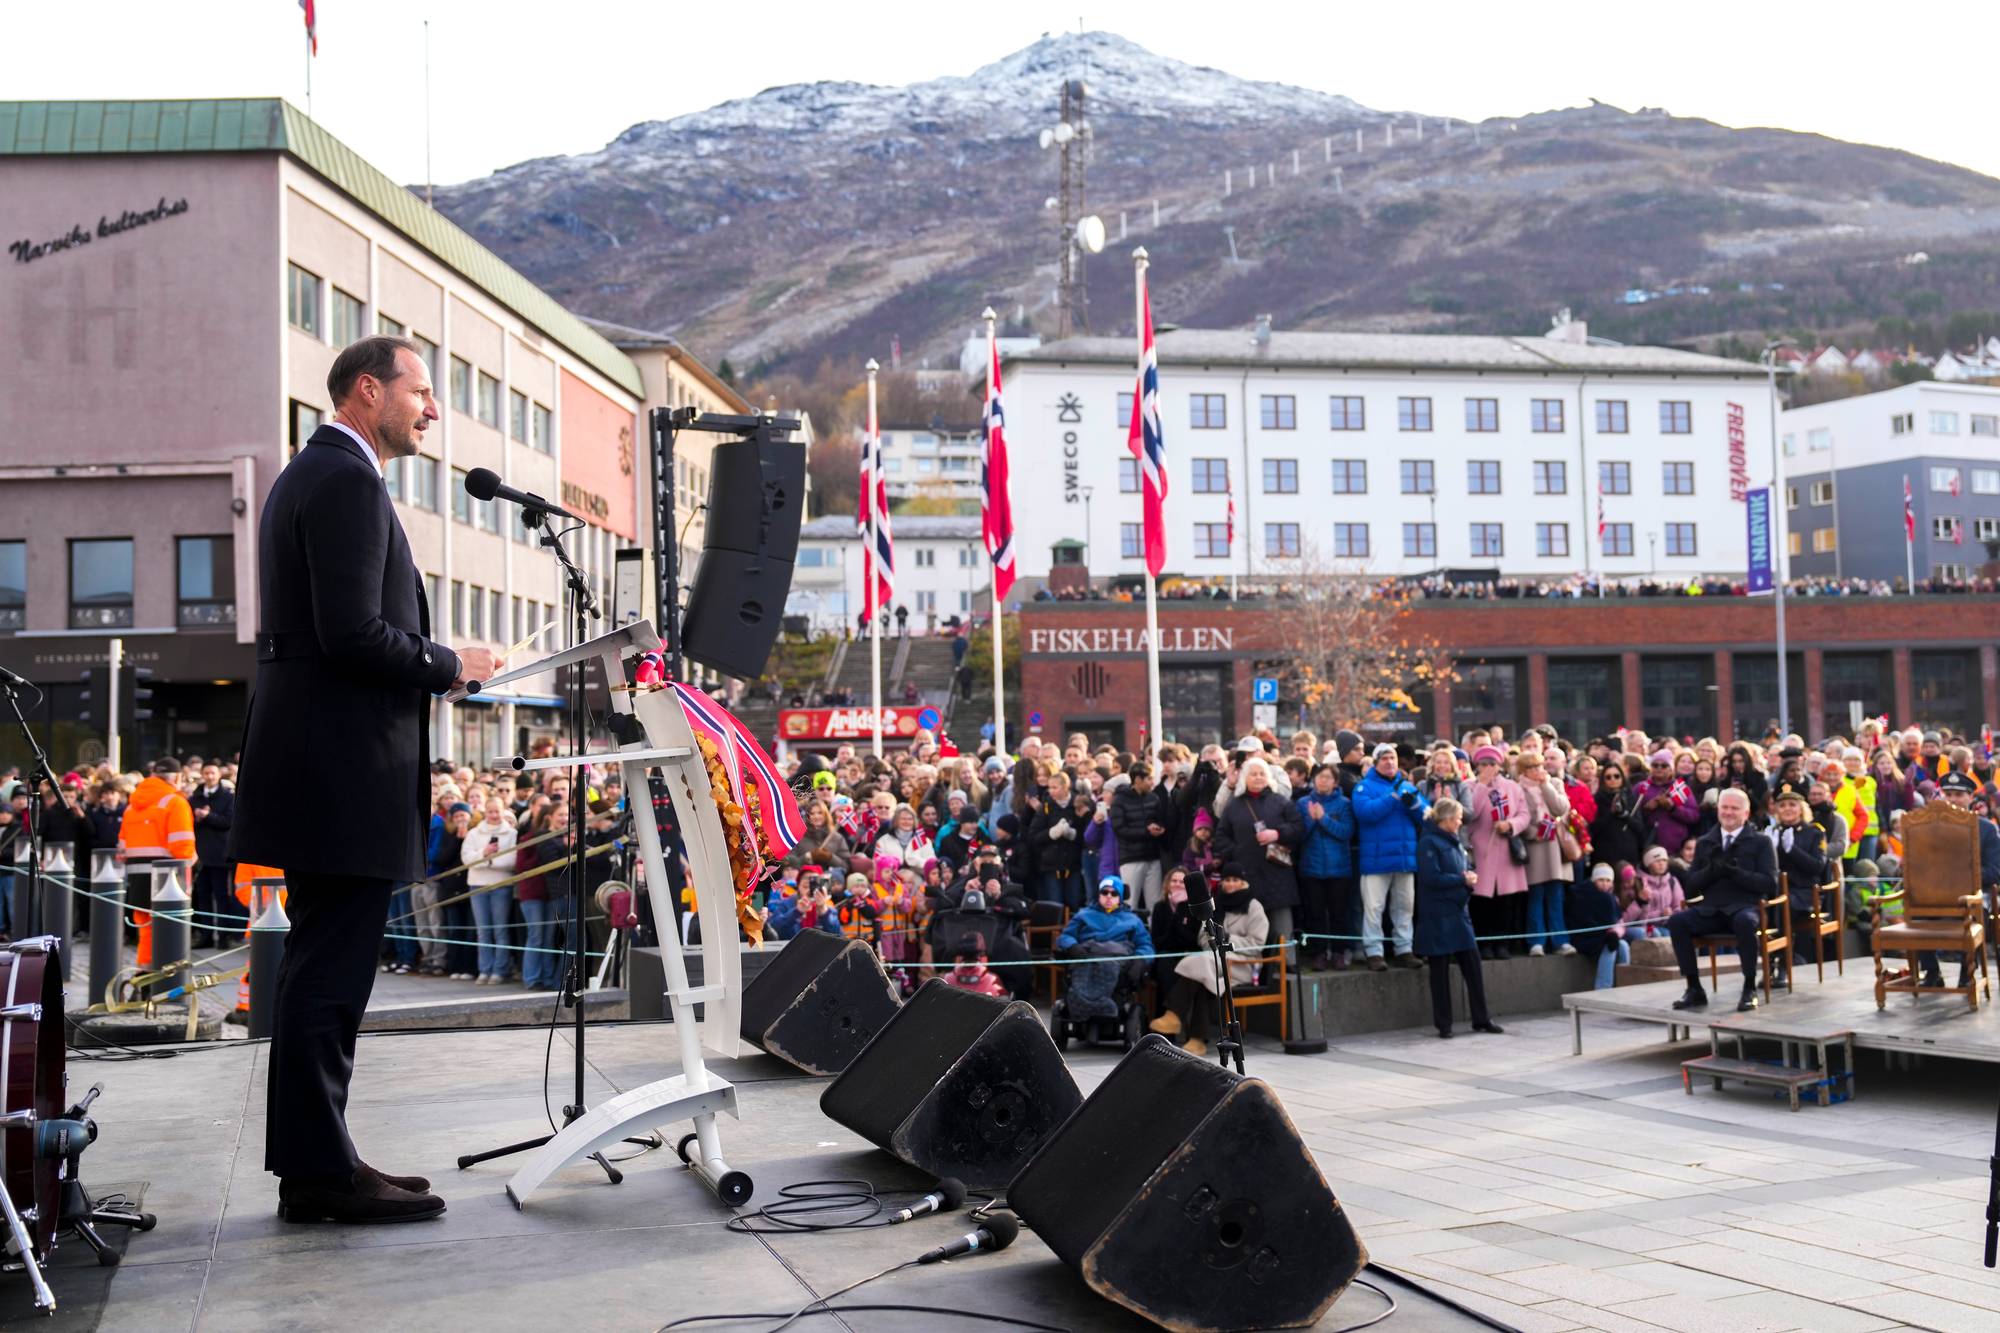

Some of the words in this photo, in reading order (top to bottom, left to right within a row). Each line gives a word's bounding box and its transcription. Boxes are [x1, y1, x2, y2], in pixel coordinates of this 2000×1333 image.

[8, 223, 91, 263] Narviks
[1063, 430, 1079, 504] SWECO
[1727, 401, 1751, 503] FREMOVER
[1751, 494, 1768, 562] NARVIK
[1258, 681, 1273, 699] P
